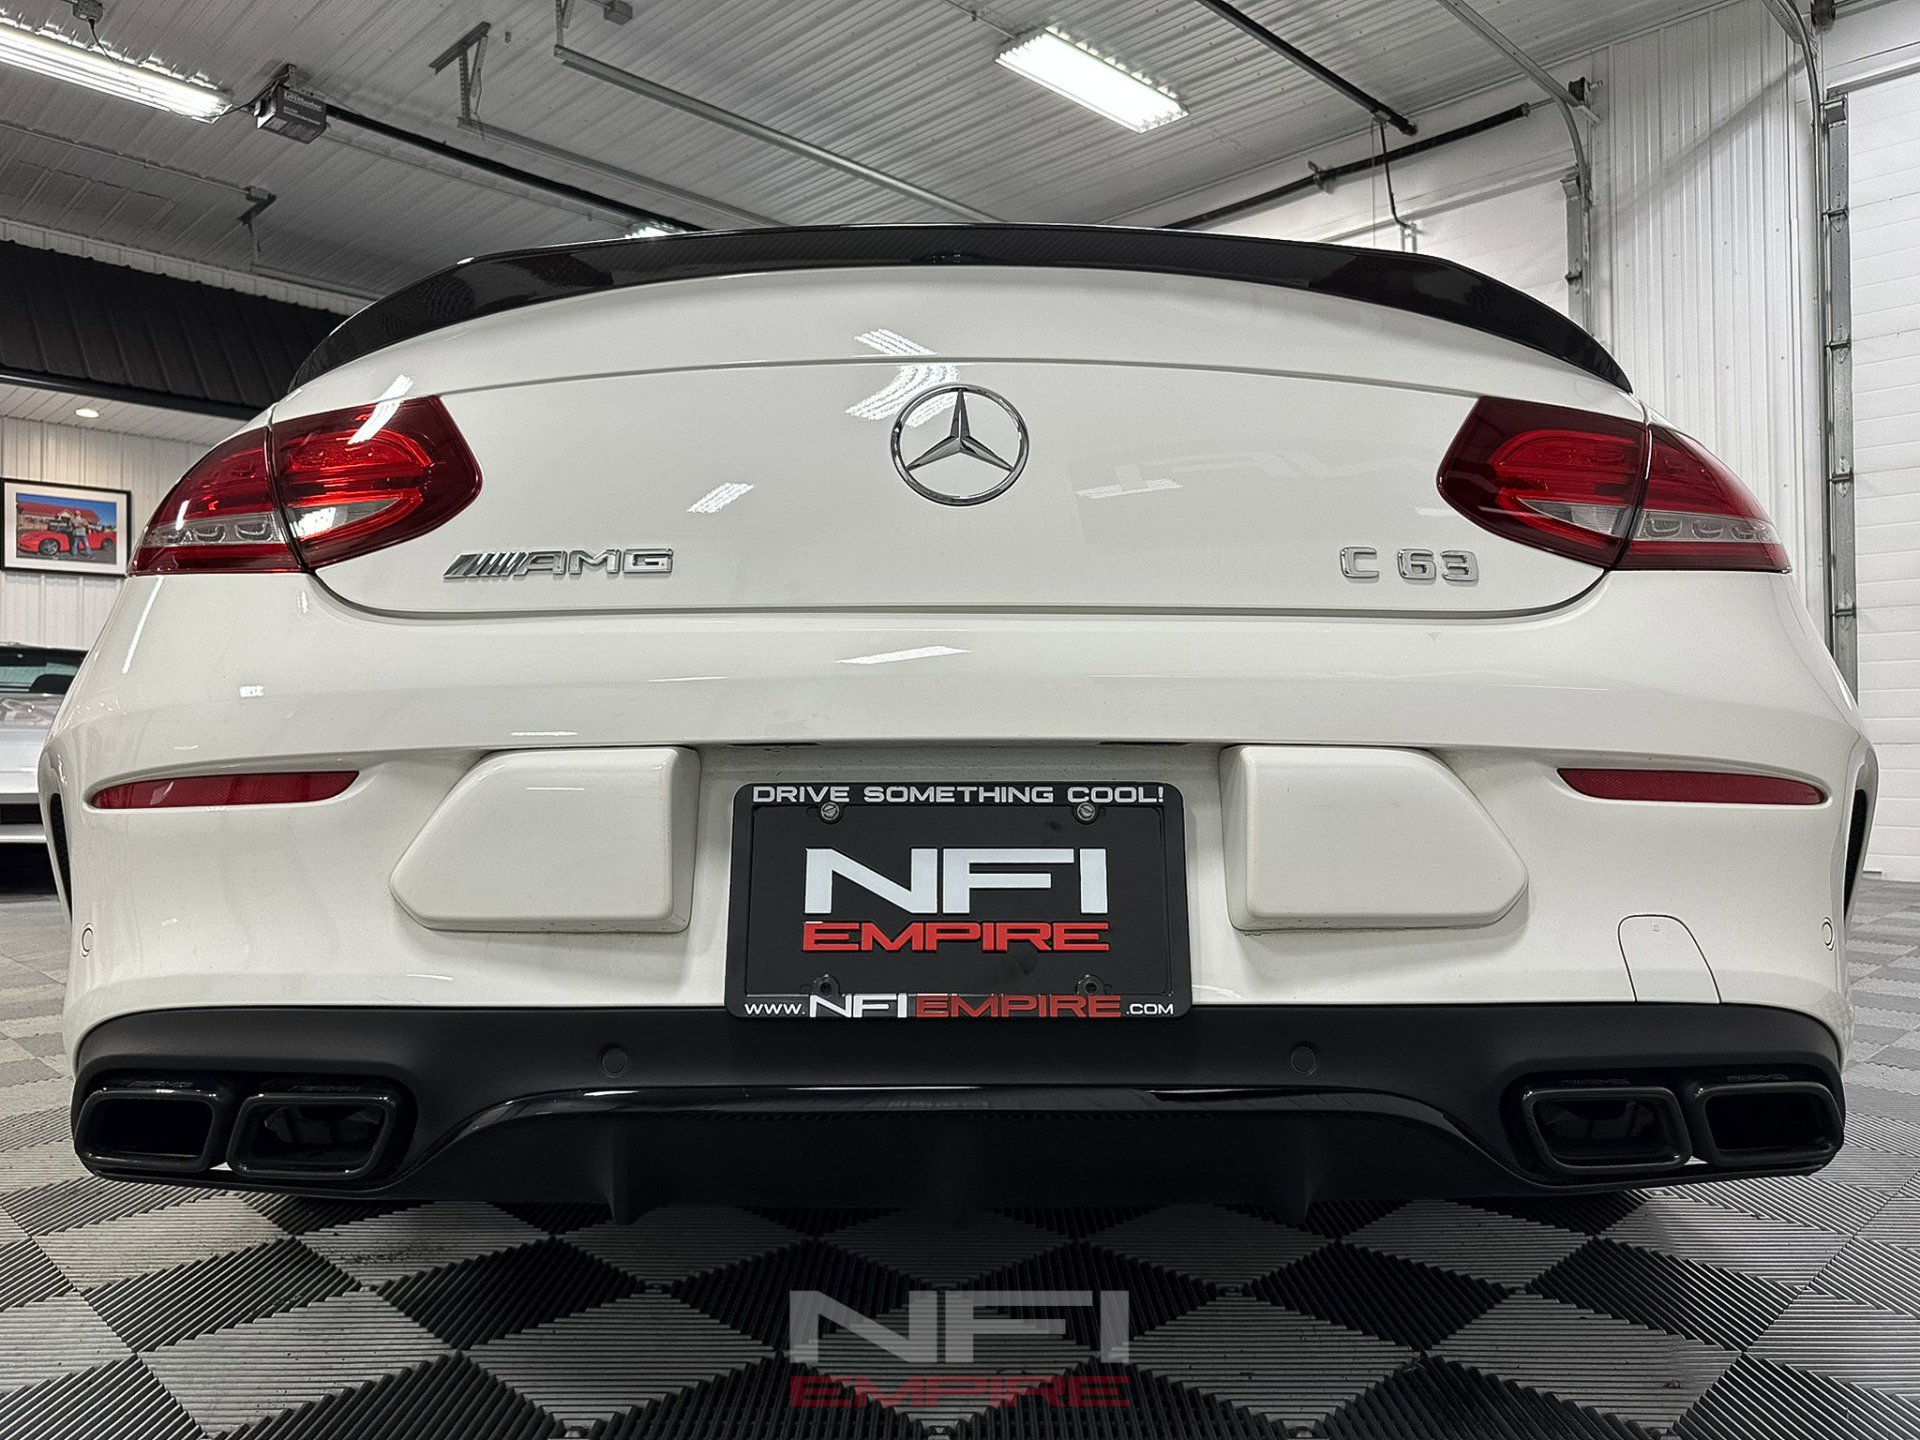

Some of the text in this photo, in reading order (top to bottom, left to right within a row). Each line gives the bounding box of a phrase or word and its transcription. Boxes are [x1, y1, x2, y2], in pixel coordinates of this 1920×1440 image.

[513, 549, 673, 577] AMG
[1340, 547, 1479, 582] C 63
[753, 786, 1164, 804] DRIVE SOMETHING COOL!
[804, 848, 1108, 914] NFI
[802, 922, 1109, 951] EMPIRE
